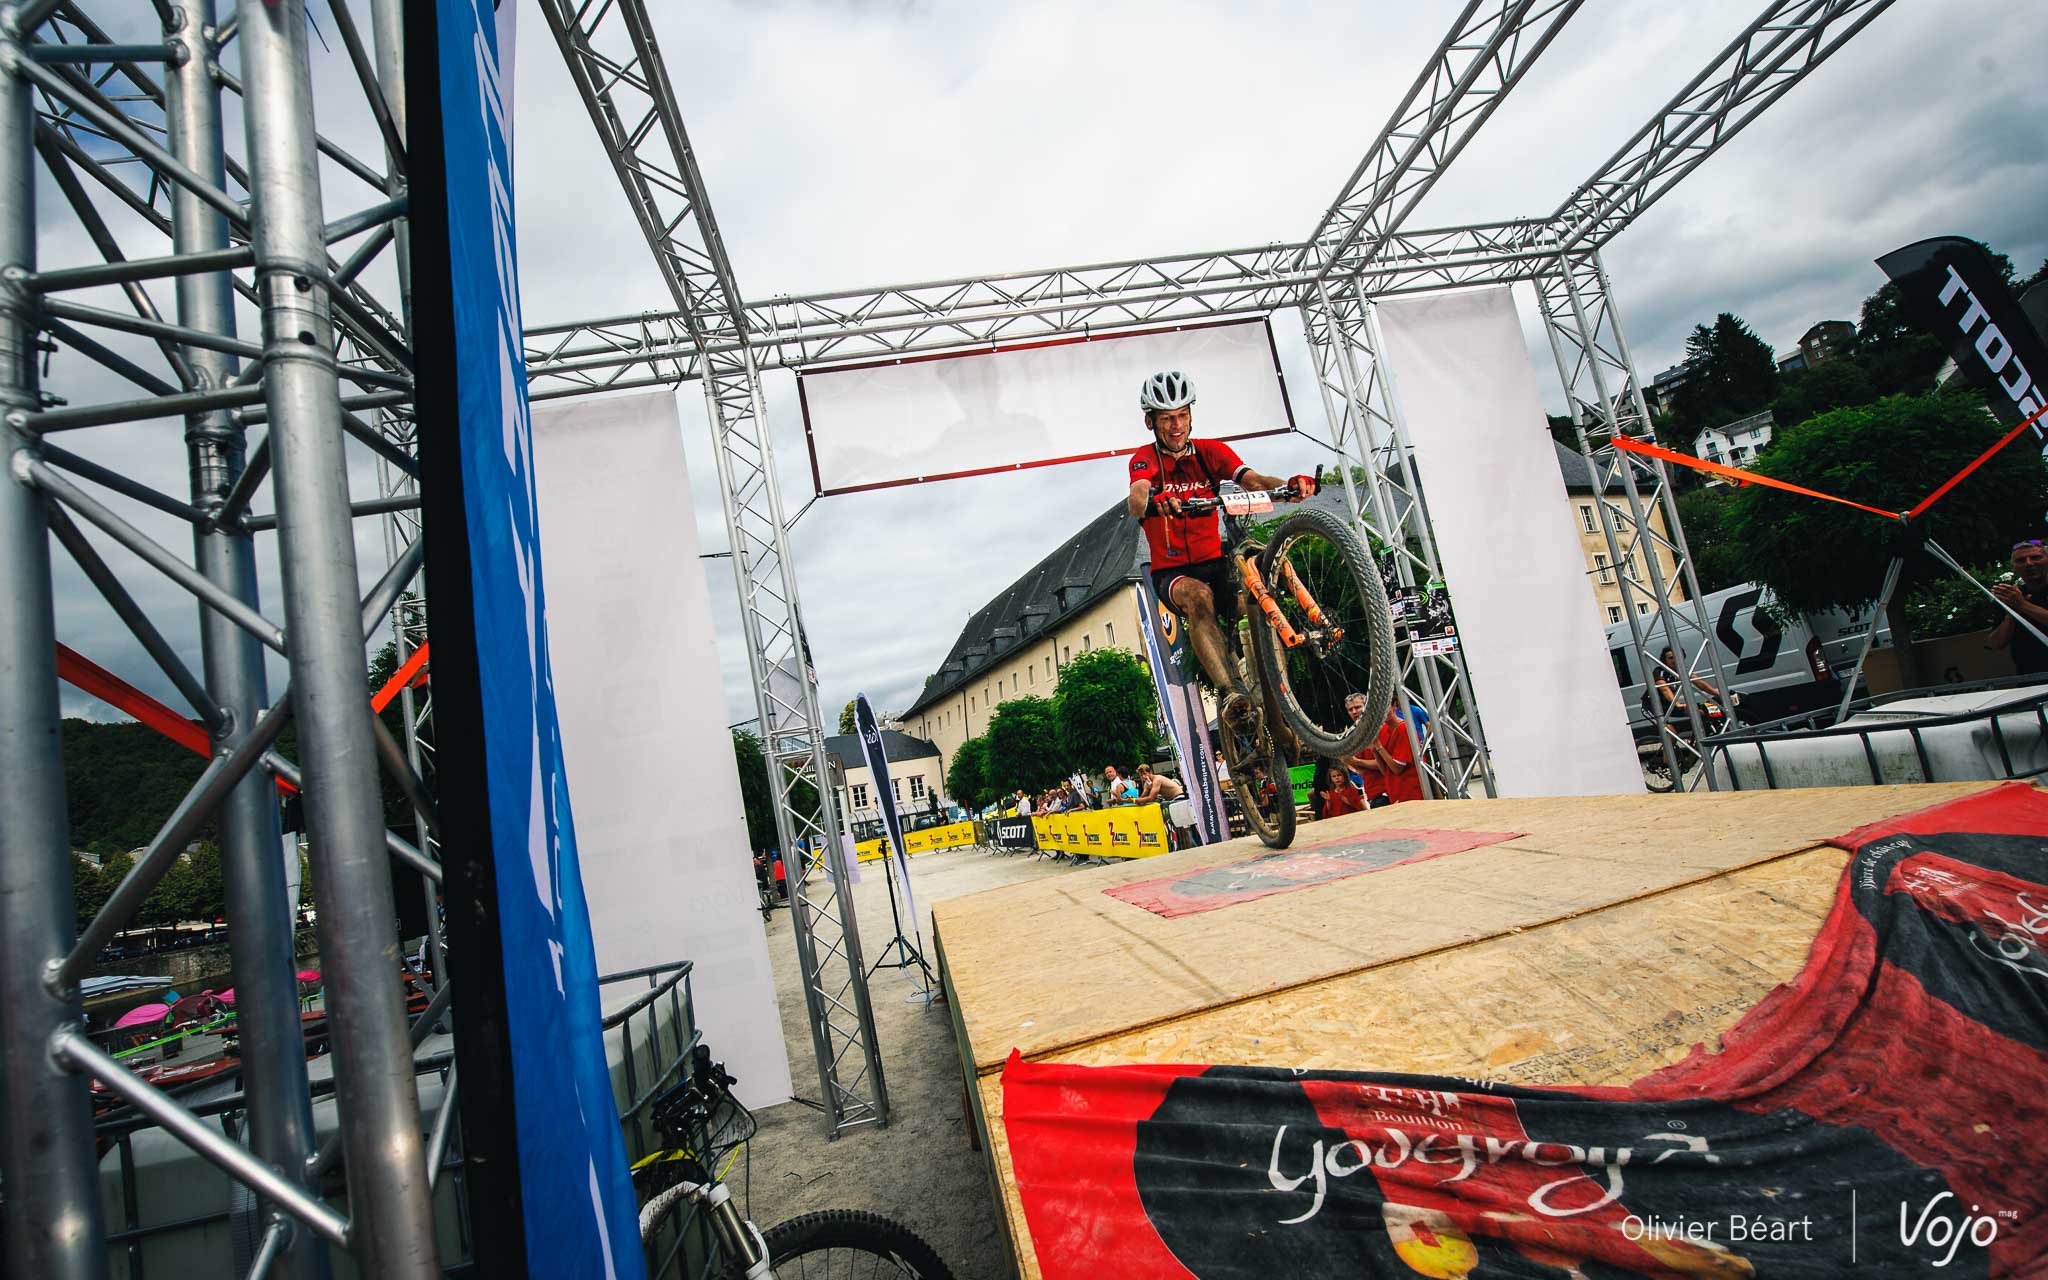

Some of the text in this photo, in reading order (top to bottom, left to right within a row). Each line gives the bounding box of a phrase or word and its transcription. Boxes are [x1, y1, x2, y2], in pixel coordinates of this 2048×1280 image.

[1838, 622, 1873, 637] SCOT
[1002, 825, 1027, 839] SCOTT
[1374, 1110, 1463, 1132] Bouillon
